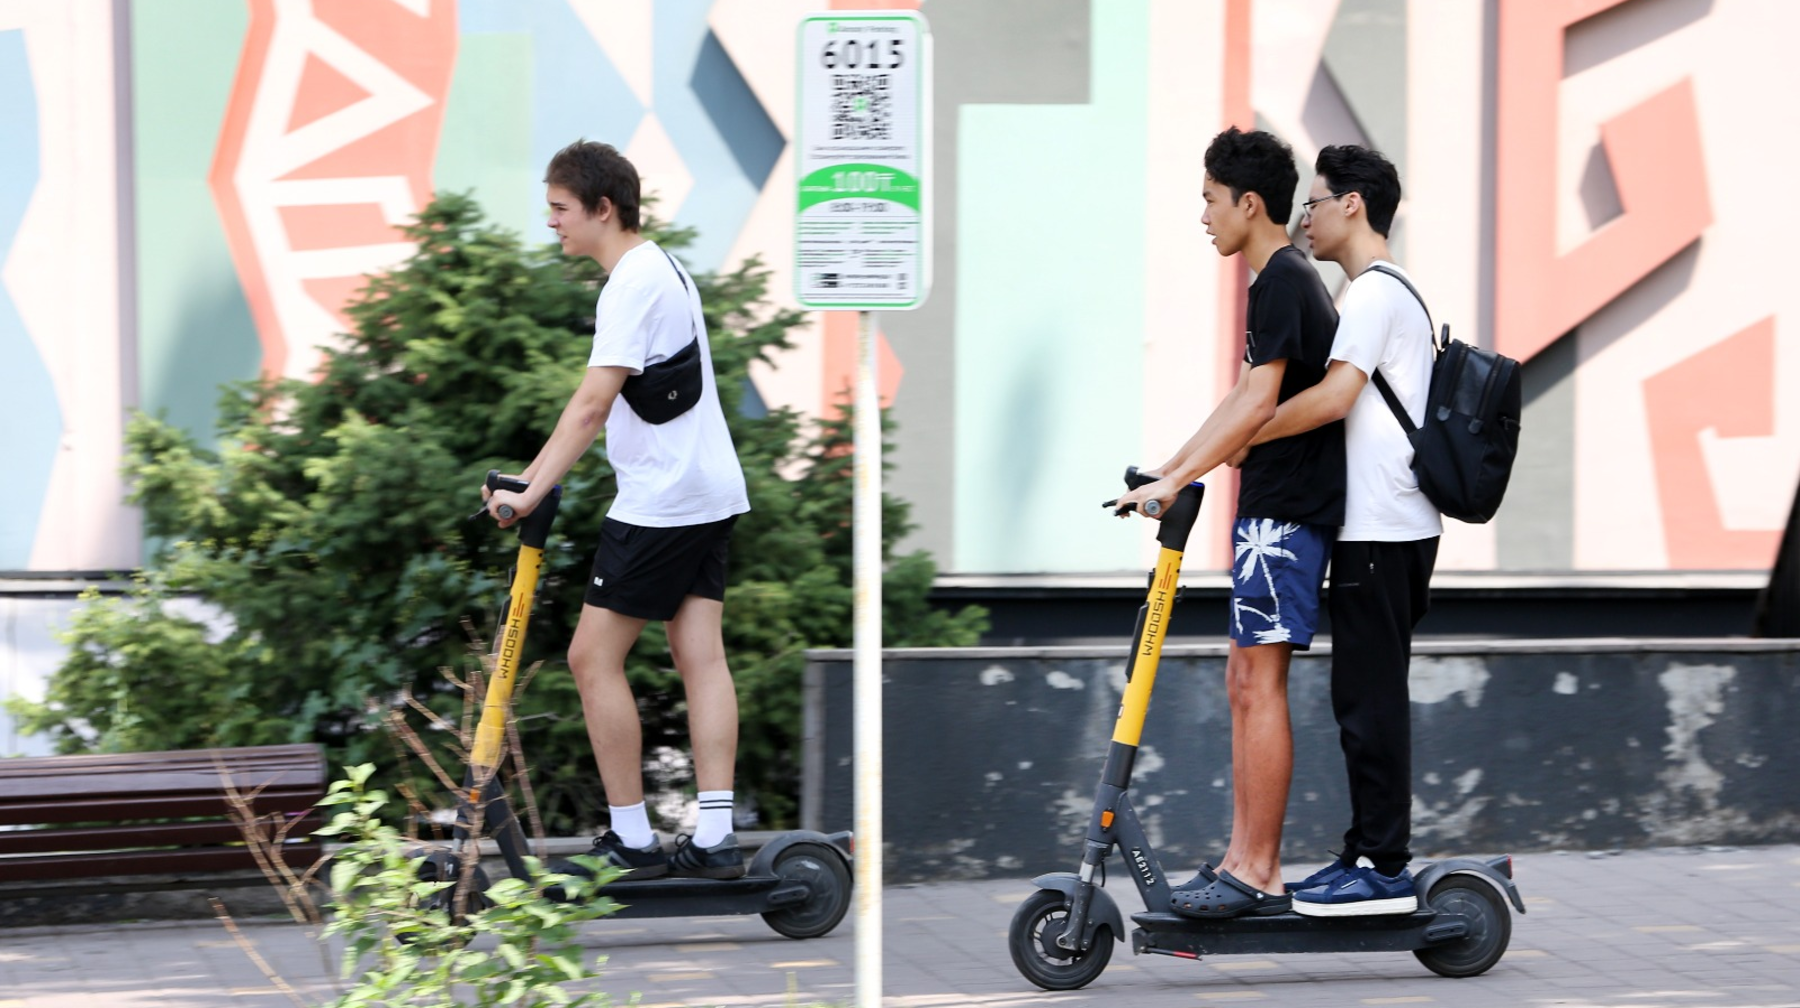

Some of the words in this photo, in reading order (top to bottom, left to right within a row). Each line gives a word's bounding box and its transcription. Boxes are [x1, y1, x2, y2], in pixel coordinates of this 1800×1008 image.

[820, 39, 905, 69] 6015
[498, 618, 521, 679] WHOOSH
[1142, 590, 1167, 656] WHOOSH
